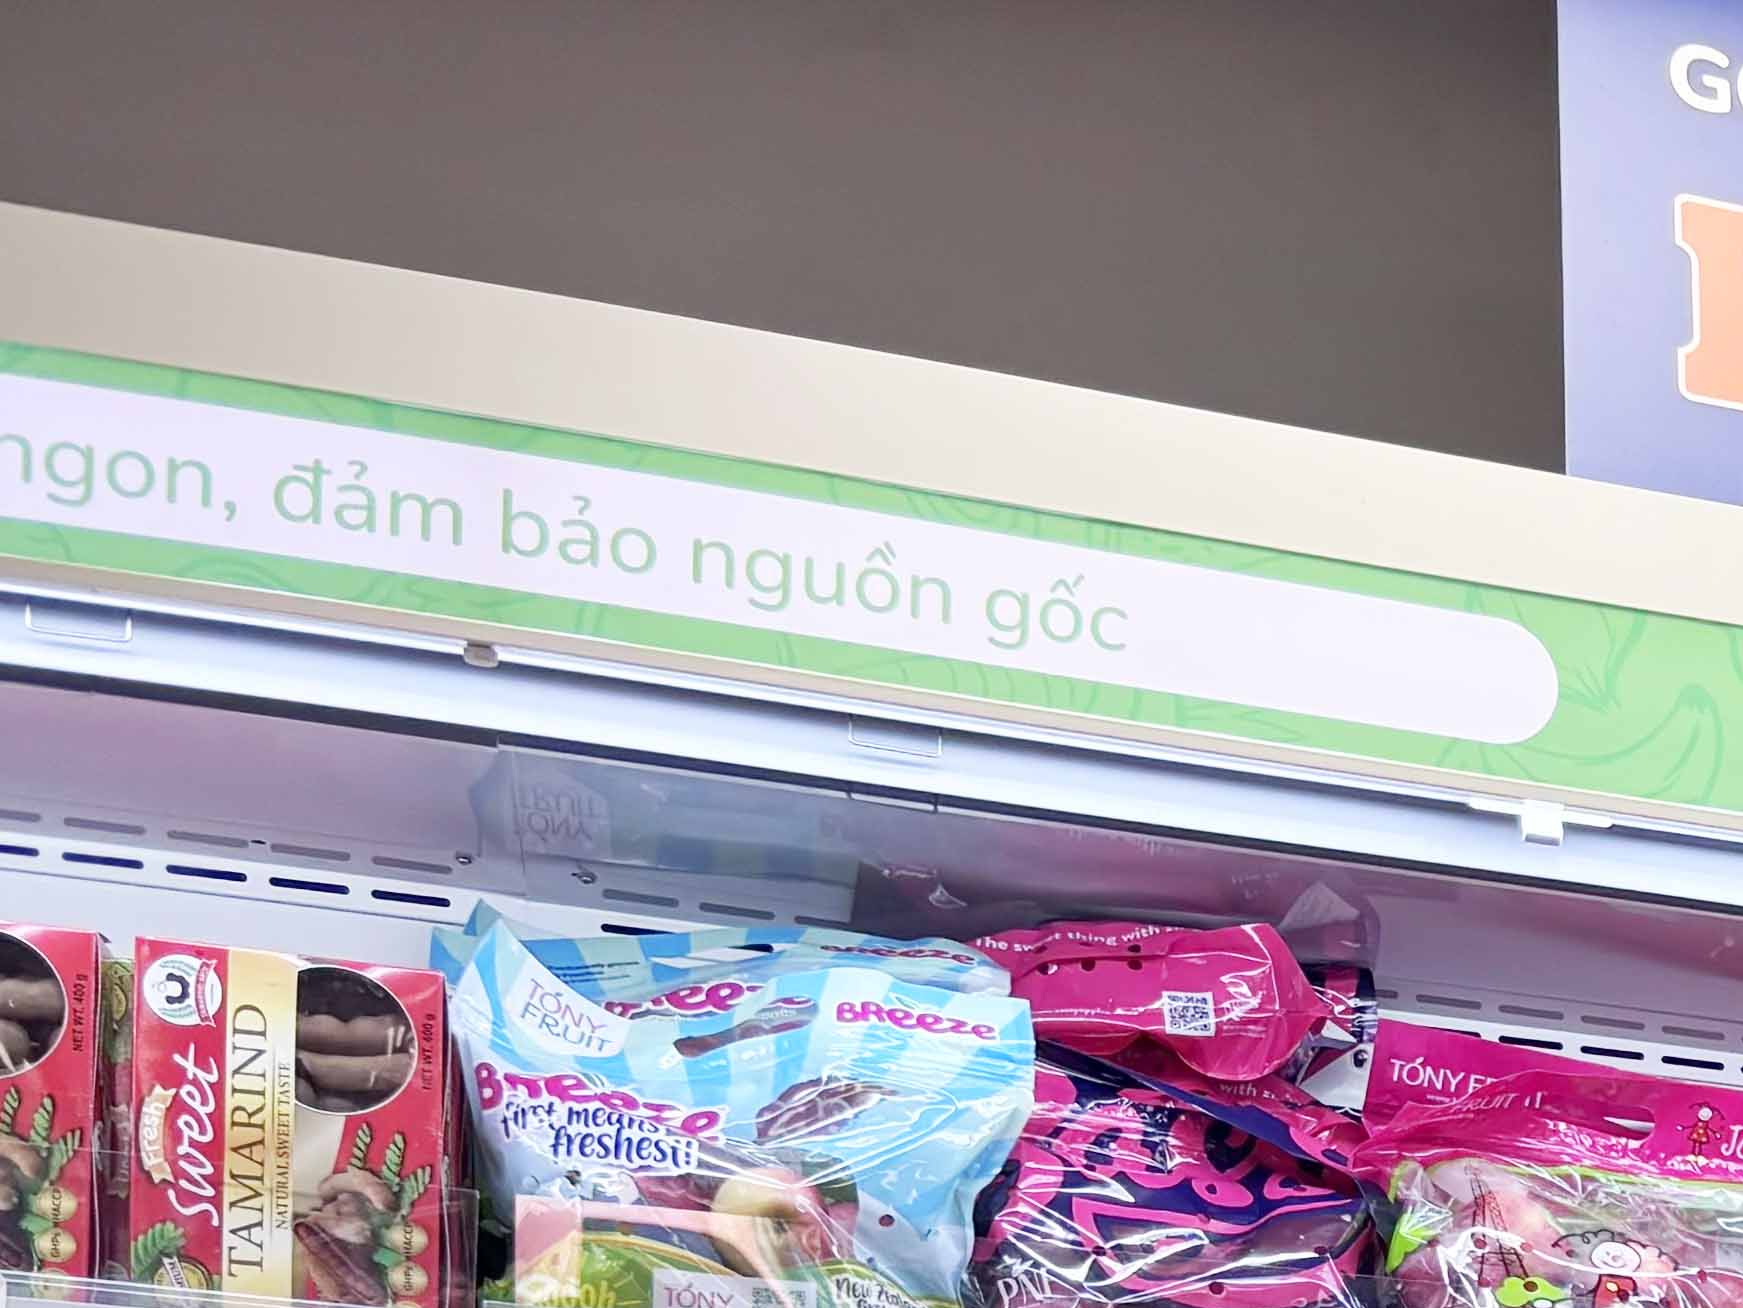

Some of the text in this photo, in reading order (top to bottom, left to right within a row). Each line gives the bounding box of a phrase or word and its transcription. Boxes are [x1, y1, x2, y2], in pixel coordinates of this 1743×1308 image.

[274, 460, 466, 548] đảm
[500, 488, 656, 574] bảo
[691, 539, 955, 626] nguồn
[984, 574, 1128, 652] gốc
[520, 1006, 611, 1053] FRUIT
[529, 978, 606, 1034] TÓNY
[1389, 1055, 1464, 1092] TÓNY
[168, 1043, 218, 1226] Sweet
[227, 1004, 268, 1277] TAMARIND
